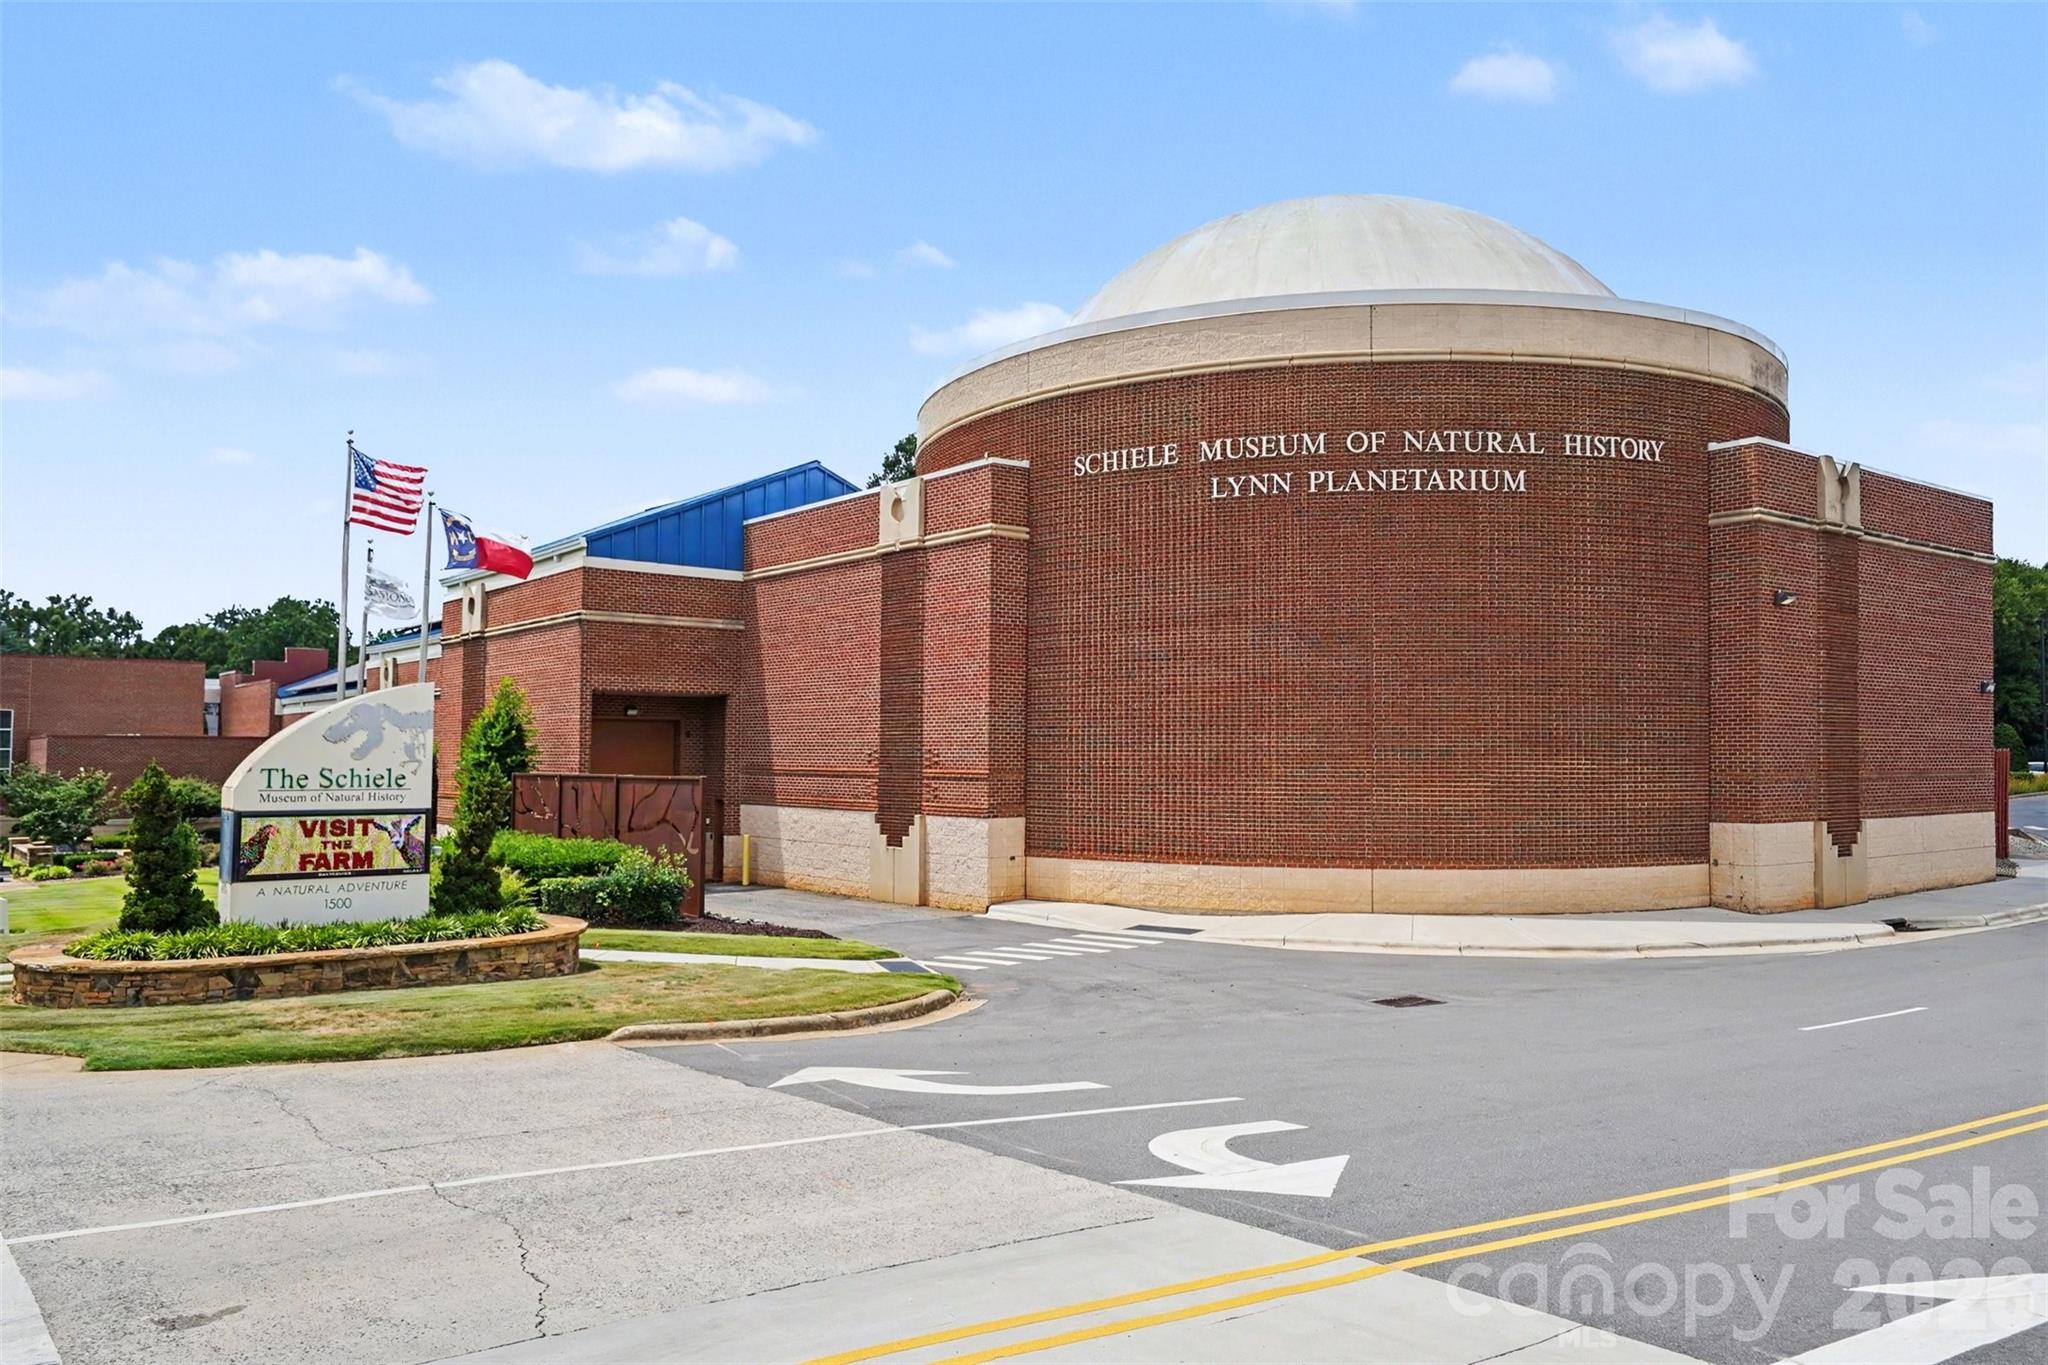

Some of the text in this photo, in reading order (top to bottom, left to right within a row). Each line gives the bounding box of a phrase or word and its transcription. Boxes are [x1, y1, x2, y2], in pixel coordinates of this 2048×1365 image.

[1074, 430, 1665, 476] SCHIELE MUSEUM OF NATURAL HISTORY
[1211, 468, 1527, 499] LYNN PLANETARIUM
[260, 767, 407, 789] The Schiele
[259, 791, 407, 804] Museum of Natural History
[298, 818, 375, 838] VISIT
[321, 840, 352, 850] THE
[298, 851, 375, 871] FARM
[256, 880, 408, 897] A NATURAL ADVENTURE
[324, 897, 352, 910] 1500
